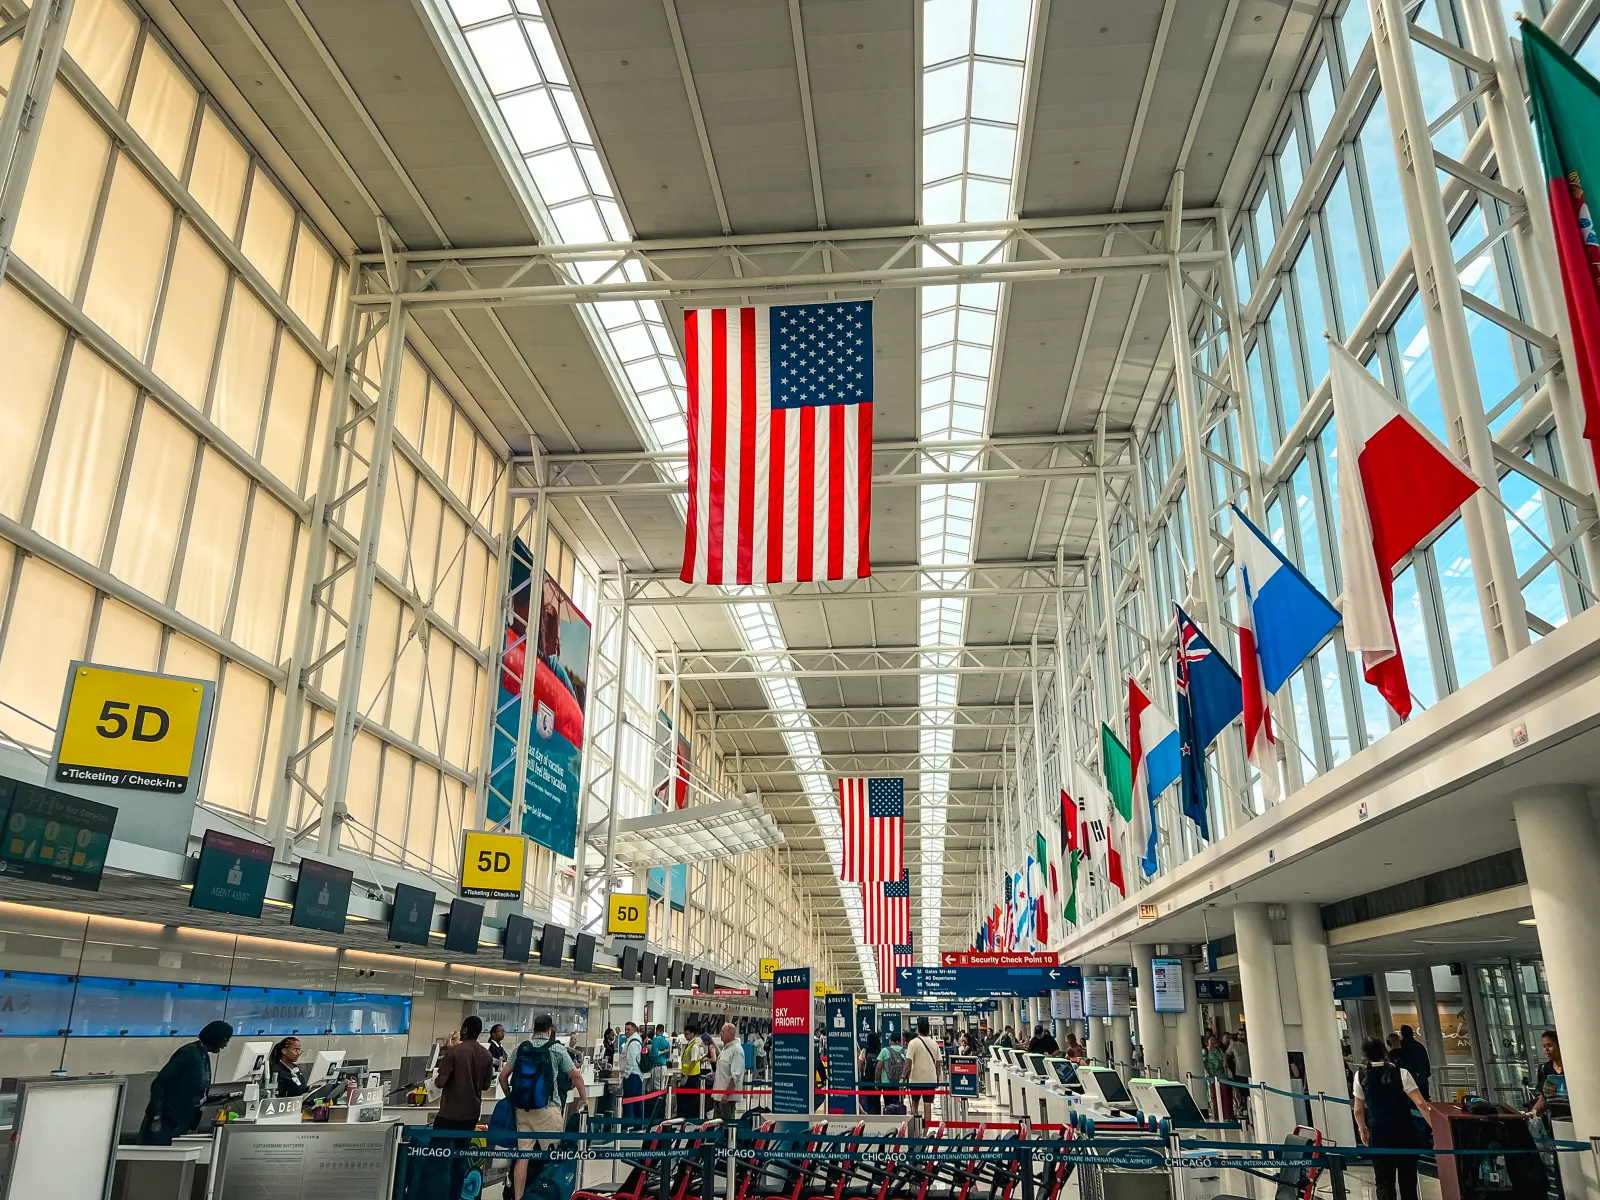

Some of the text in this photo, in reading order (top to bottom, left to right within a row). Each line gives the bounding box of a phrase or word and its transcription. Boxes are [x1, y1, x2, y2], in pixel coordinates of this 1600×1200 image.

[96, 700, 170, 742] 5D
[548, 759, 565, 777] vacation
[68, 769, 176, 788] Ticketing / Check-In
[477, 850, 511, 873] 5D
[210, 886, 251, 902] AGENT ASSIST
[467, 889, 490, 897] Ticketing
[617, 906, 639, 922] 5D
[1141, 904, 1154, 915] EXIT
[970, 956, 999, 965] Security
[1000, 956, 1023, 964] Check
[764, 965, 775, 974] 5C
[782, 975, 801, 984] DELTA
[775, 1008, 788, 1017] SKY
[775, 1017, 805, 1027] PRIORITY
[479, 1150, 520, 1158] INTERNATIONAL
[549, 1150, 597, 1160] CHICAGO
[714, 1148, 755, 1159] HICAGO
[861, 1152, 907, 1162] CHICAGO
[1084, 1156, 1129, 1164] INTERNATIONAL
[1164, 1157, 1212, 1168] CHICAGO
[1220, 1159, 1243, 1167] O'HARE
[1242, 1159, 1288, 1167] INTERNATIONAL
